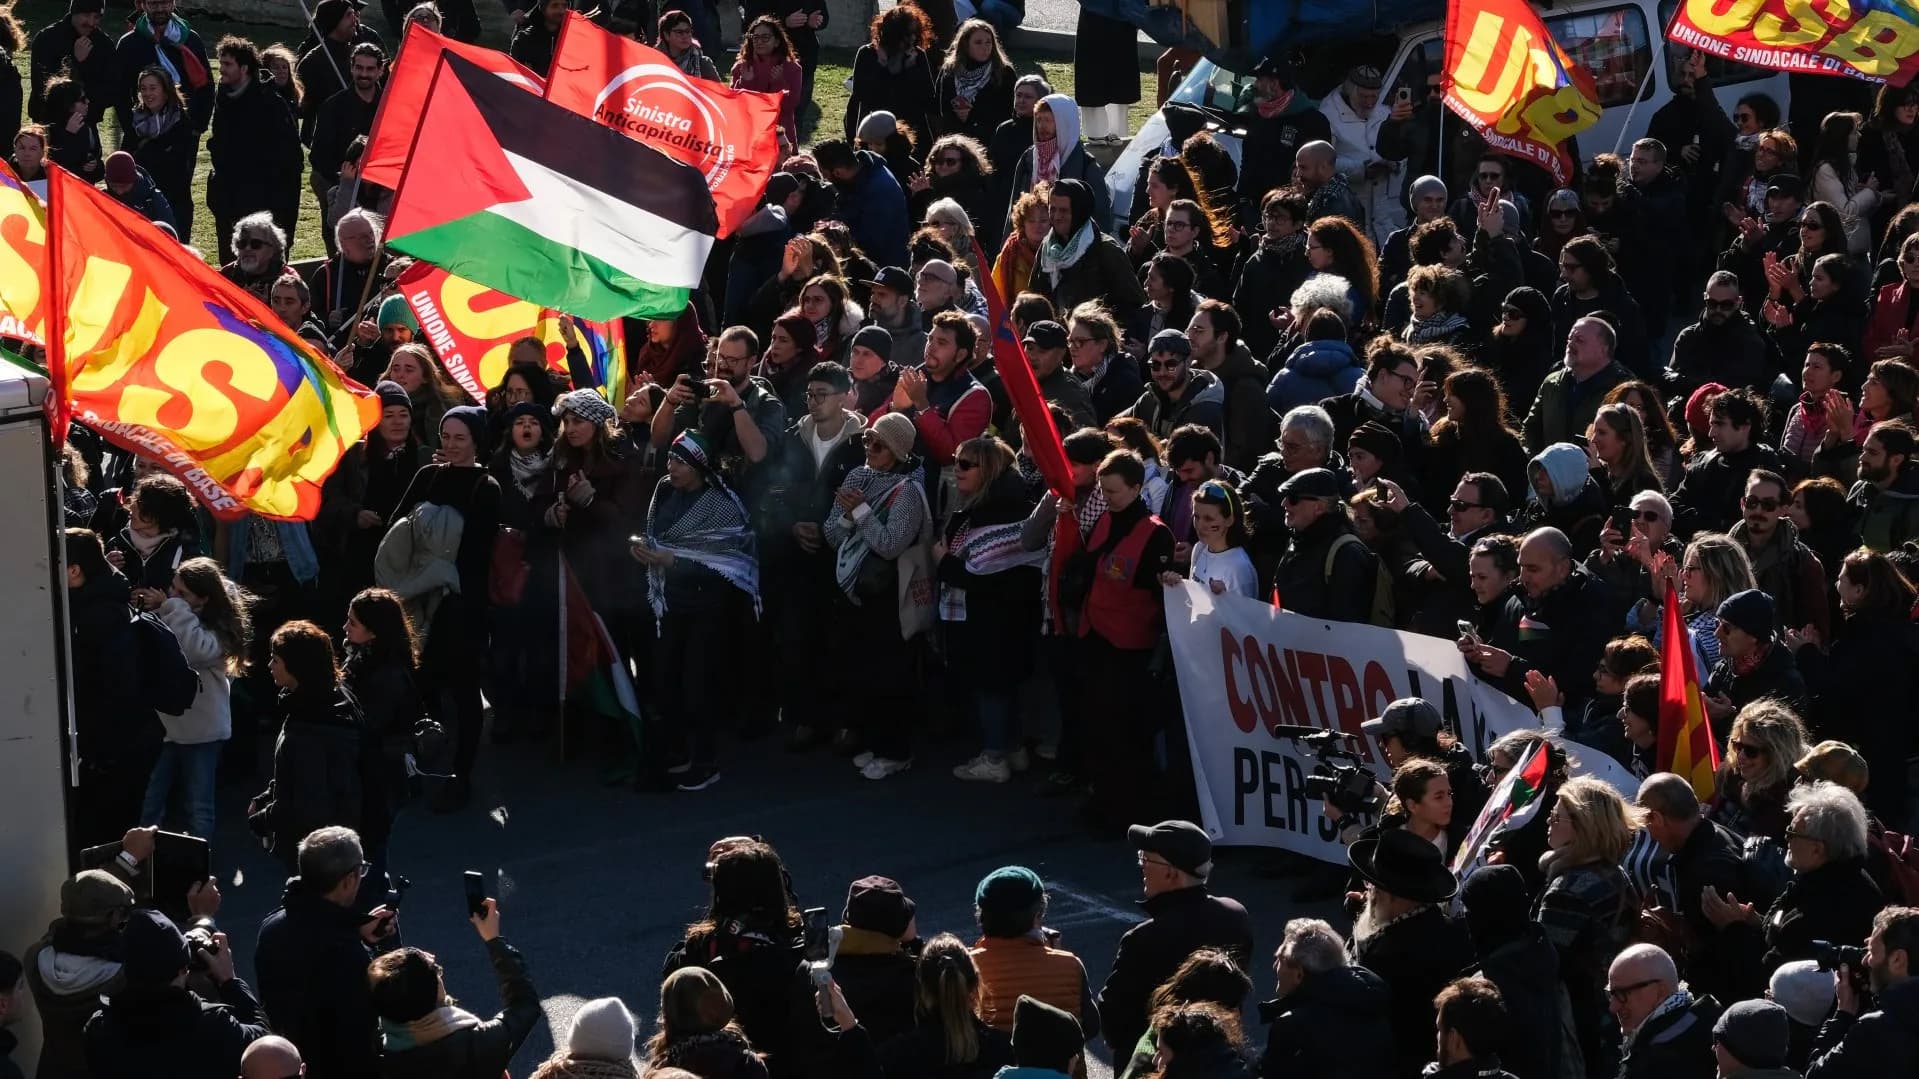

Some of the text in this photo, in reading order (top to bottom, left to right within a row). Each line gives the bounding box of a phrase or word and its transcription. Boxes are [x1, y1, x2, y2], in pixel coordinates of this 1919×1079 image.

[1672, 22, 1732, 56] UNIONE
[1734, 46, 1818, 69] SINDACALE
[1823, 57, 1840, 72] DI
[594, 103, 723, 157] Anticapitalista
[623, 97, 693, 132] Sinistra
[1538, 149, 1550, 163] DI
[411, 290, 456, 355] UNIONE
[183, 467, 238, 511] BASE
[1221, 627, 1398, 769] CONTRO
[1233, 746, 1308, 835] PER
